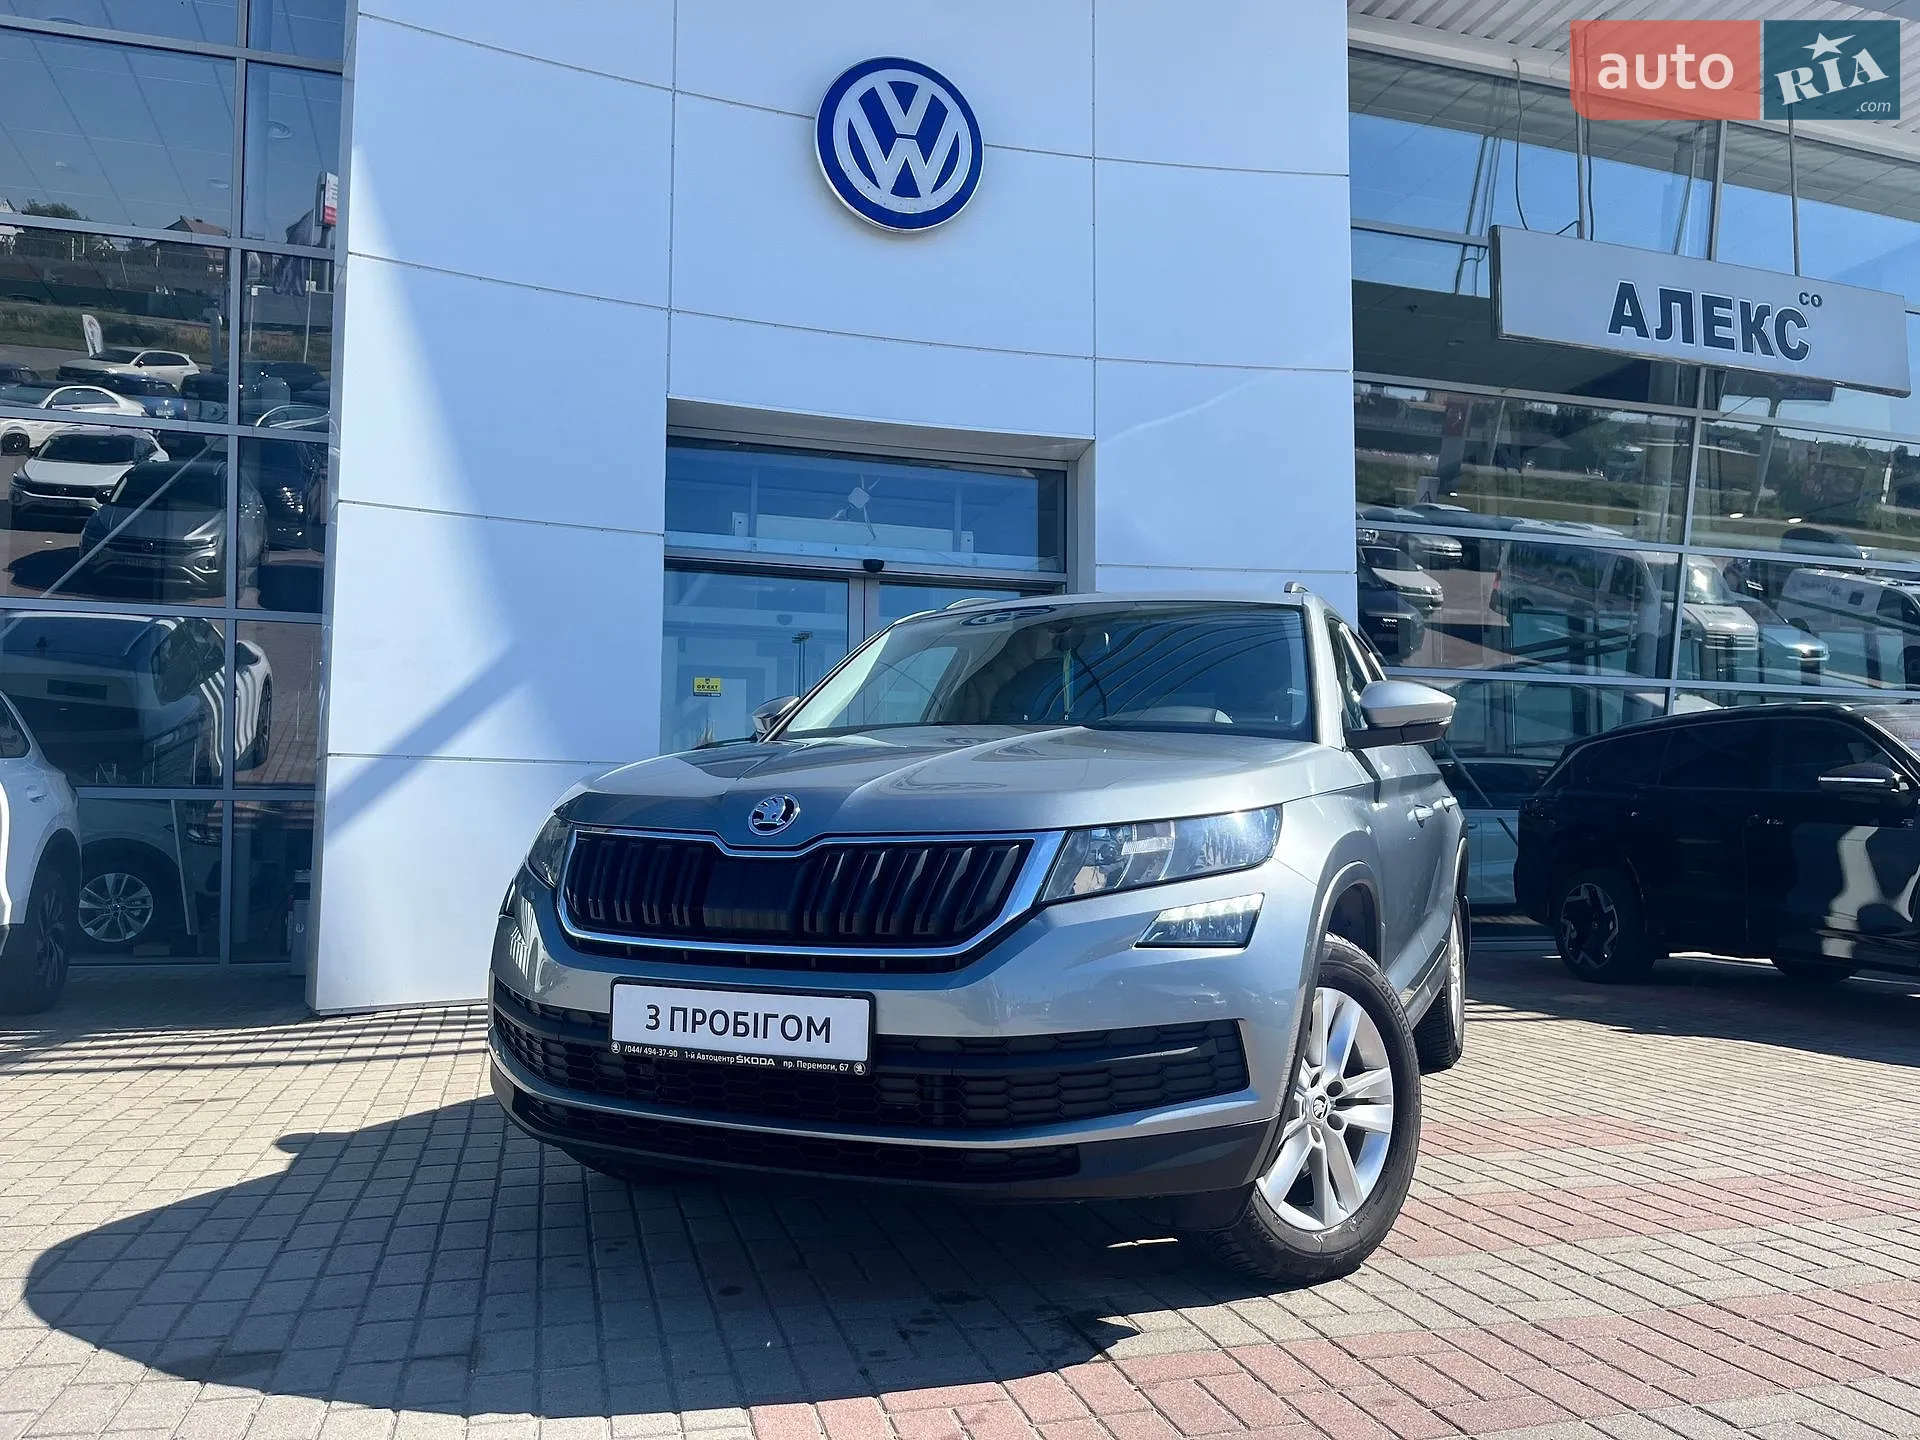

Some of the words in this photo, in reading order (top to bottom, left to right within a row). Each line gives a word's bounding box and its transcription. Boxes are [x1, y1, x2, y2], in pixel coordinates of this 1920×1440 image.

[1607, 280, 1811, 362] АЛЕКС
[669, 1006, 831, 1044] ПРОБІГОМ
[643, 1047, 678, 1058] 494-37-90
[696, 1052, 735, 1065] Автоцентр
[736, 1054, 776, 1066] ŠKODA
[796, 1060, 838, 1072] Перемоги,
[839, 1062, 849, 1072] 67
